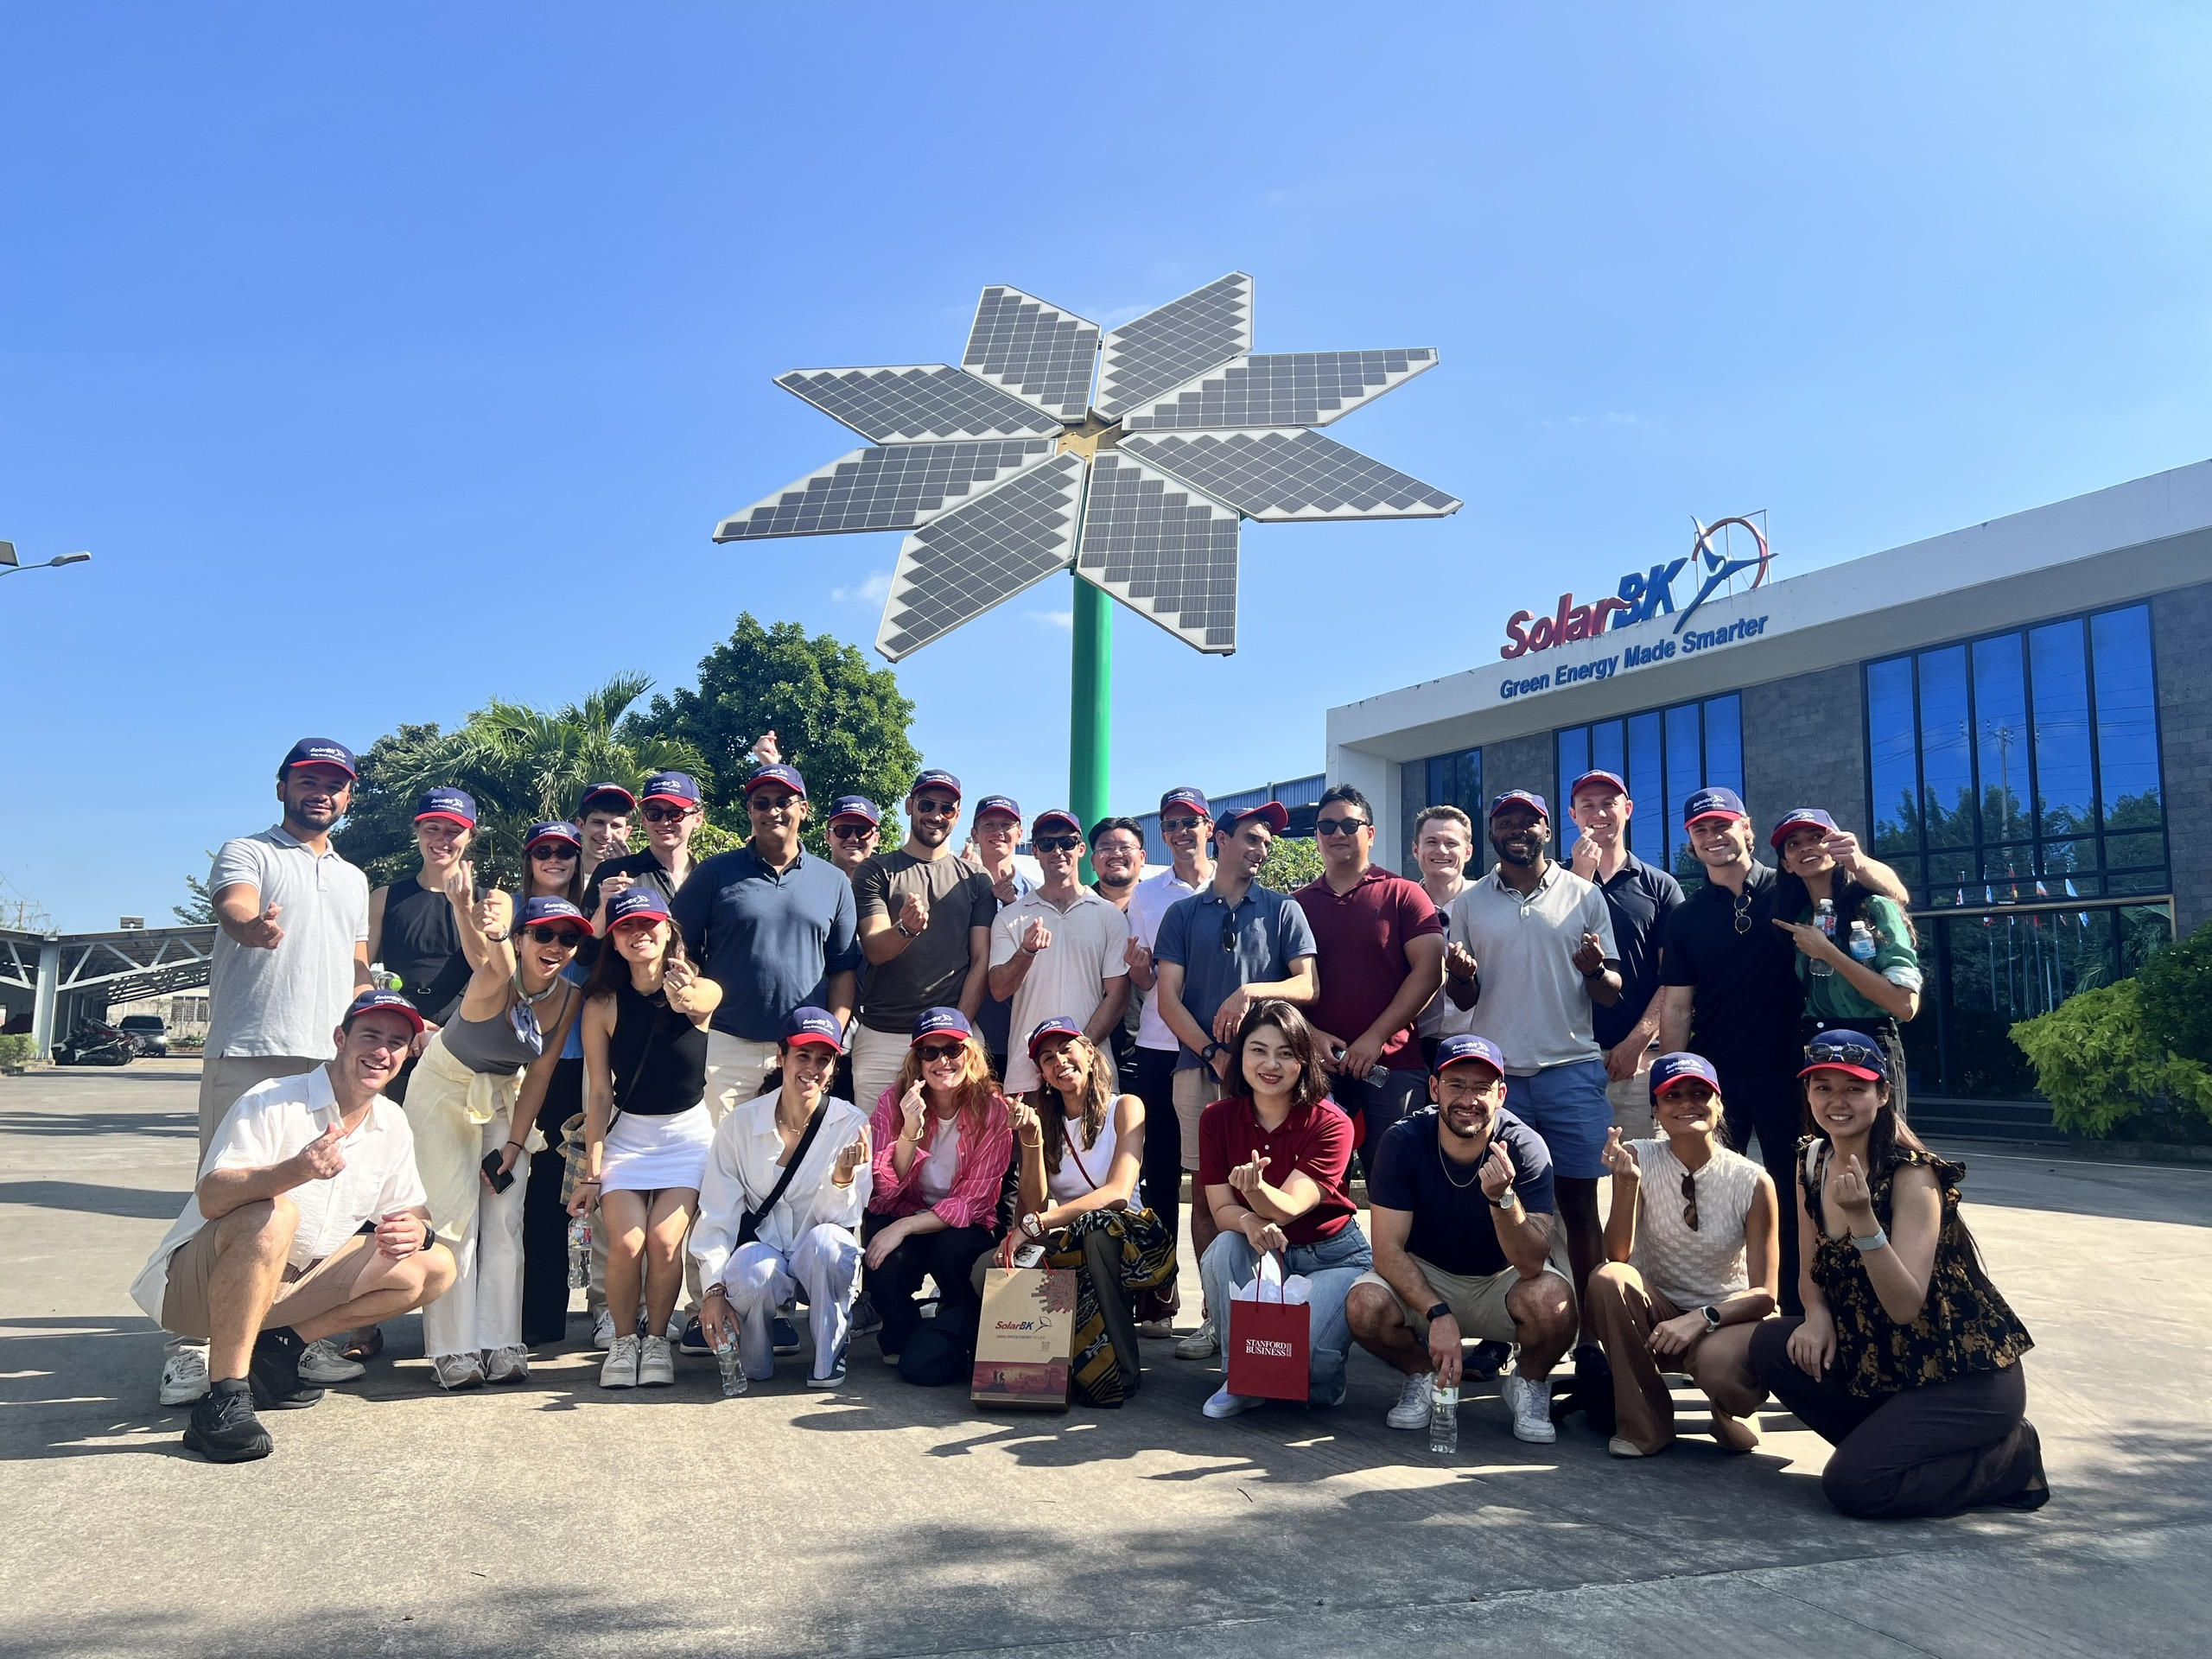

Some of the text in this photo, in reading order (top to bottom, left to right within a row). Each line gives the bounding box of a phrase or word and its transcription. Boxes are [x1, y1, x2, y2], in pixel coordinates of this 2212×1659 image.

[1500, 557, 1688, 659] SolarBK
[1500, 615, 1770, 699] Green Energy Made Smarter
[995, 1321, 1034, 1330] SolarBK
[1246, 1338, 1287, 1350] STANFORD
[1246, 1345, 1287, 1357] BUSINESS
